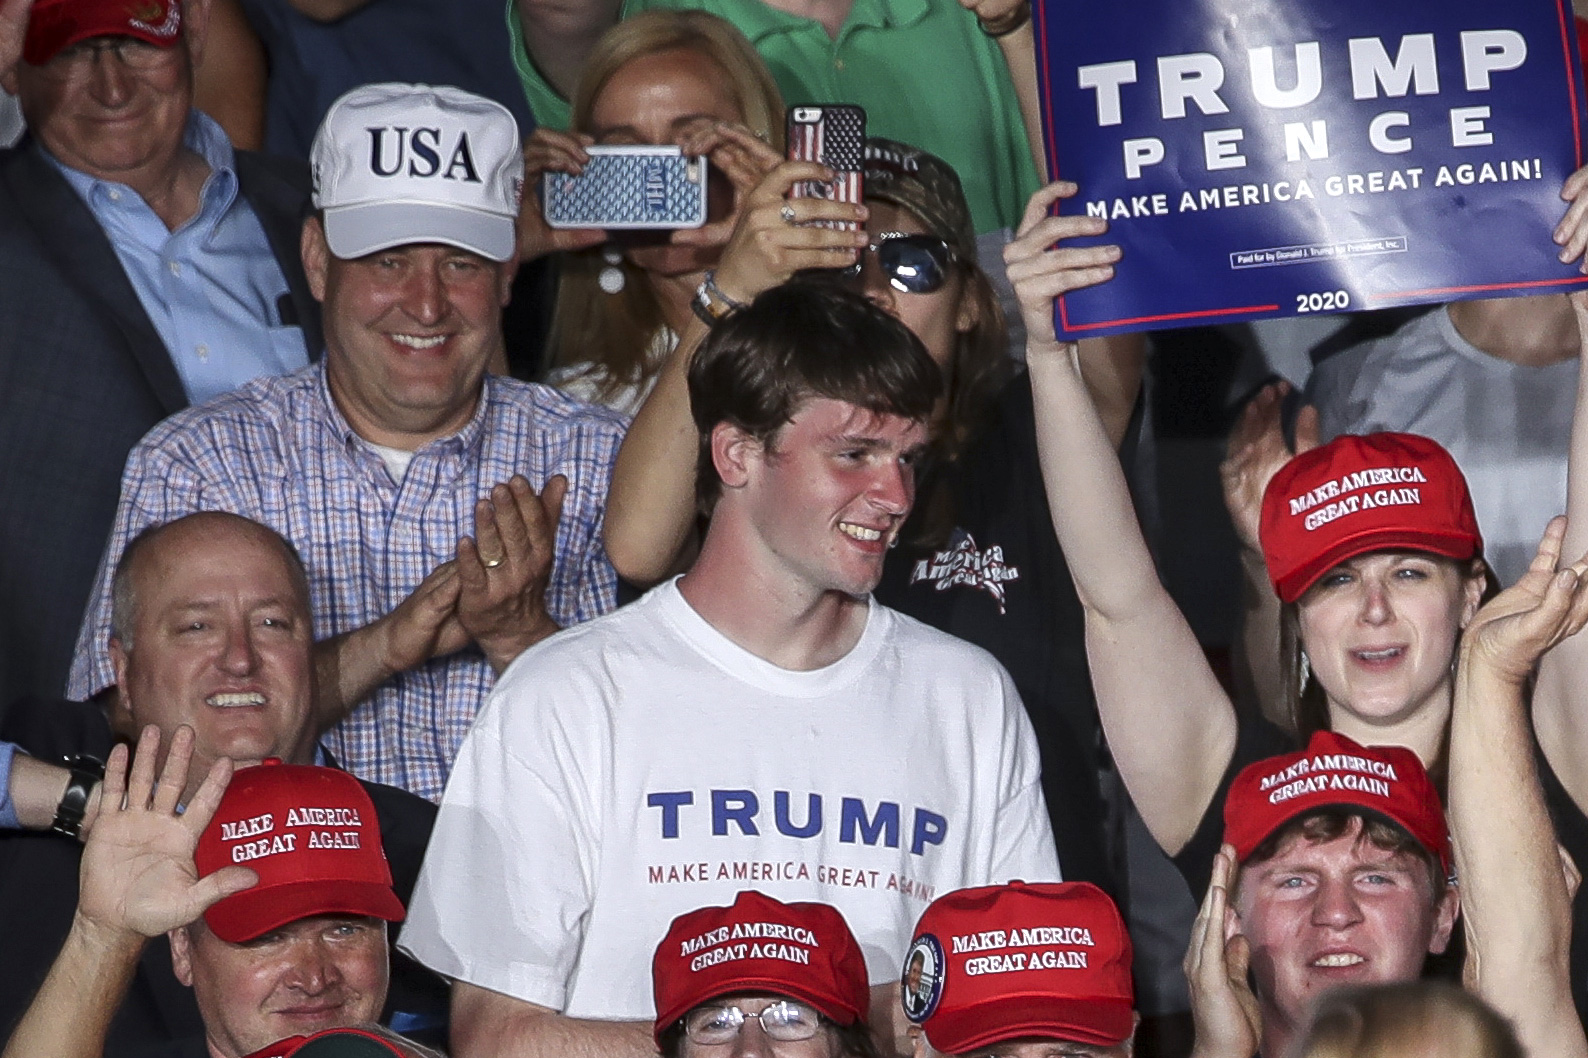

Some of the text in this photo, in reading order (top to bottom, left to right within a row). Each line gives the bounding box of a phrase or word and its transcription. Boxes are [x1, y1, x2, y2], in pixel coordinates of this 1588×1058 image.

[1077, 29, 1527, 126] TRUMP
[366, 126, 483, 184] USA
[1123, 106, 1494, 180] PENCE
[1086, 157, 1543, 221] MAKE AMERICA GREAT AGAIN!
[1296, 290, 1350, 312] 2020
[1289, 466, 1427, 516] MAKE AMERICA
[1304, 488, 1421, 531] GREAT AGAIN
[1259, 754, 1398, 791] MAKE AMERICA
[1269, 774, 1389, 805] GREAT AGAIN
[221, 807, 362, 841] MAKE AMERICA
[647, 789, 948, 856] TRUMP
[232, 830, 360, 863] GREAT AGAIN
[647, 862, 709, 884] MAKE
[715, 861, 810, 881] AMERICA
[816, 864, 880, 889] GREAT
[680, 922, 819, 957] MAKE AMERICA
[951, 926, 1095, 954] MAKE AMERICA
[690, 943, 810, 972] GREAT AGAIN
[965, 951, 1088, 976] GREAT AGAIN
